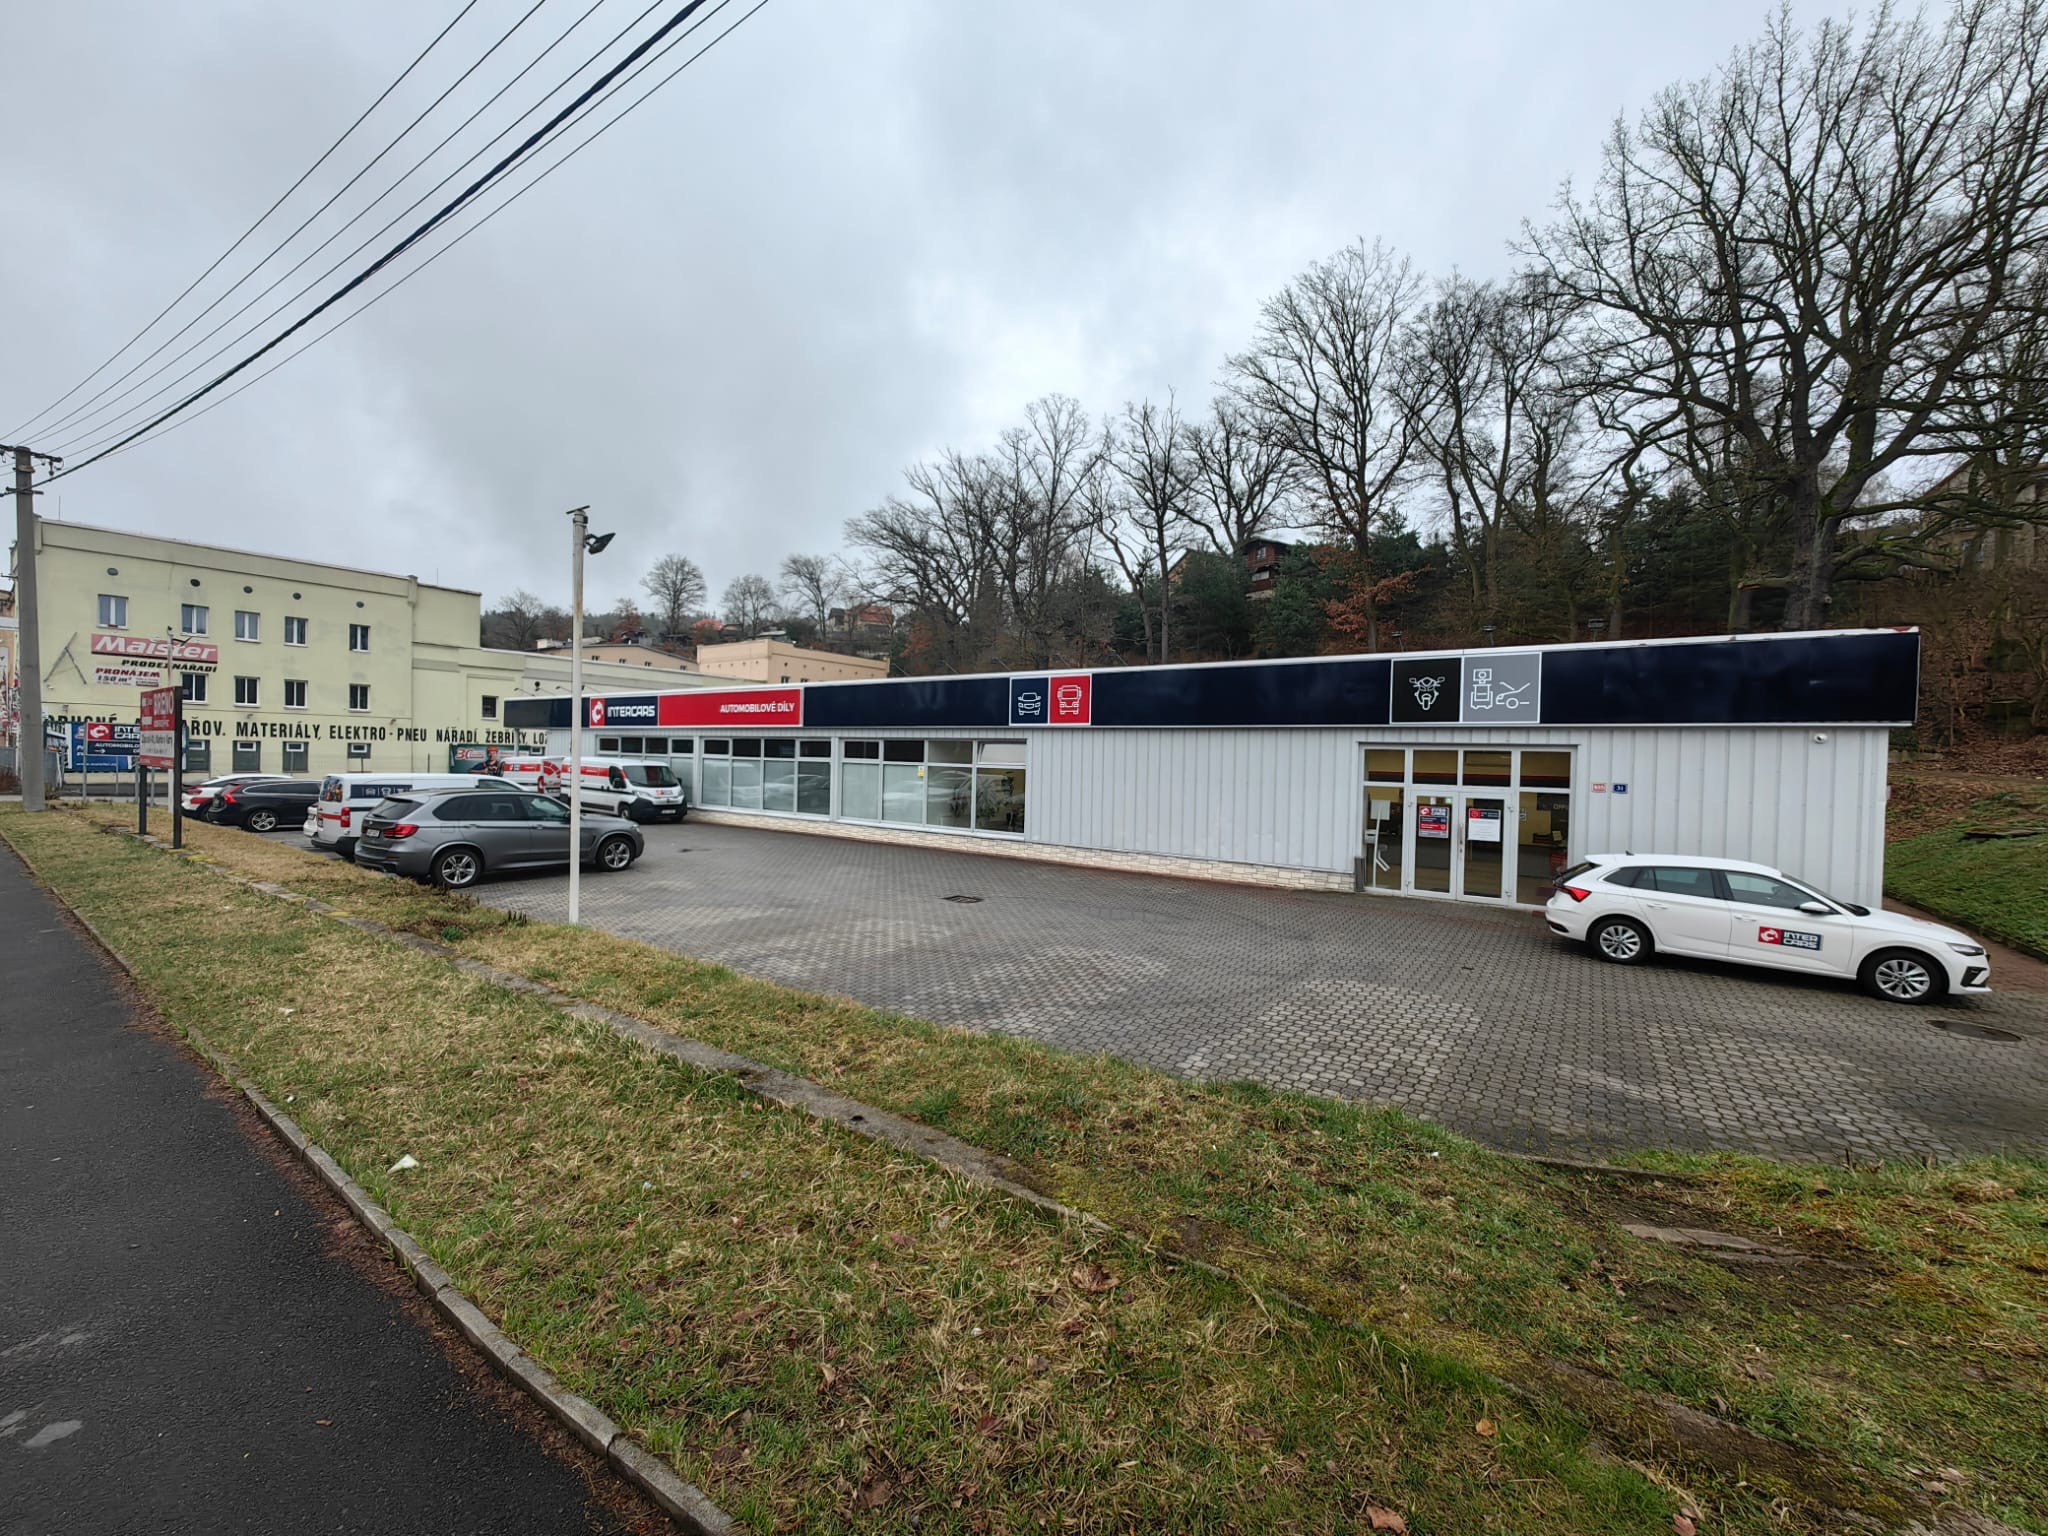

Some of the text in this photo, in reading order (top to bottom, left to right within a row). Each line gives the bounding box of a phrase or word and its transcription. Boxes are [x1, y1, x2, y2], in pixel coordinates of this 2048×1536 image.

[95, 636, 217, 659] Maister
[121, 659, 168, 669] PRODEJ
[95, 667, 160, 678] PRONÁJEM
[720, 700, 795, 713] AUTOMOBILOVÉ DÍLY
[114, 726, 140, 734] INTE
[236, 720, 321, 740] MATERIÁLY,
[329, 725, 386, 741] ELEKTRO
[397, 728, 427, 742] PNEU
[1783, 931, 1818, 942] INTER
[1783, 938, 1817, 949] CARS
